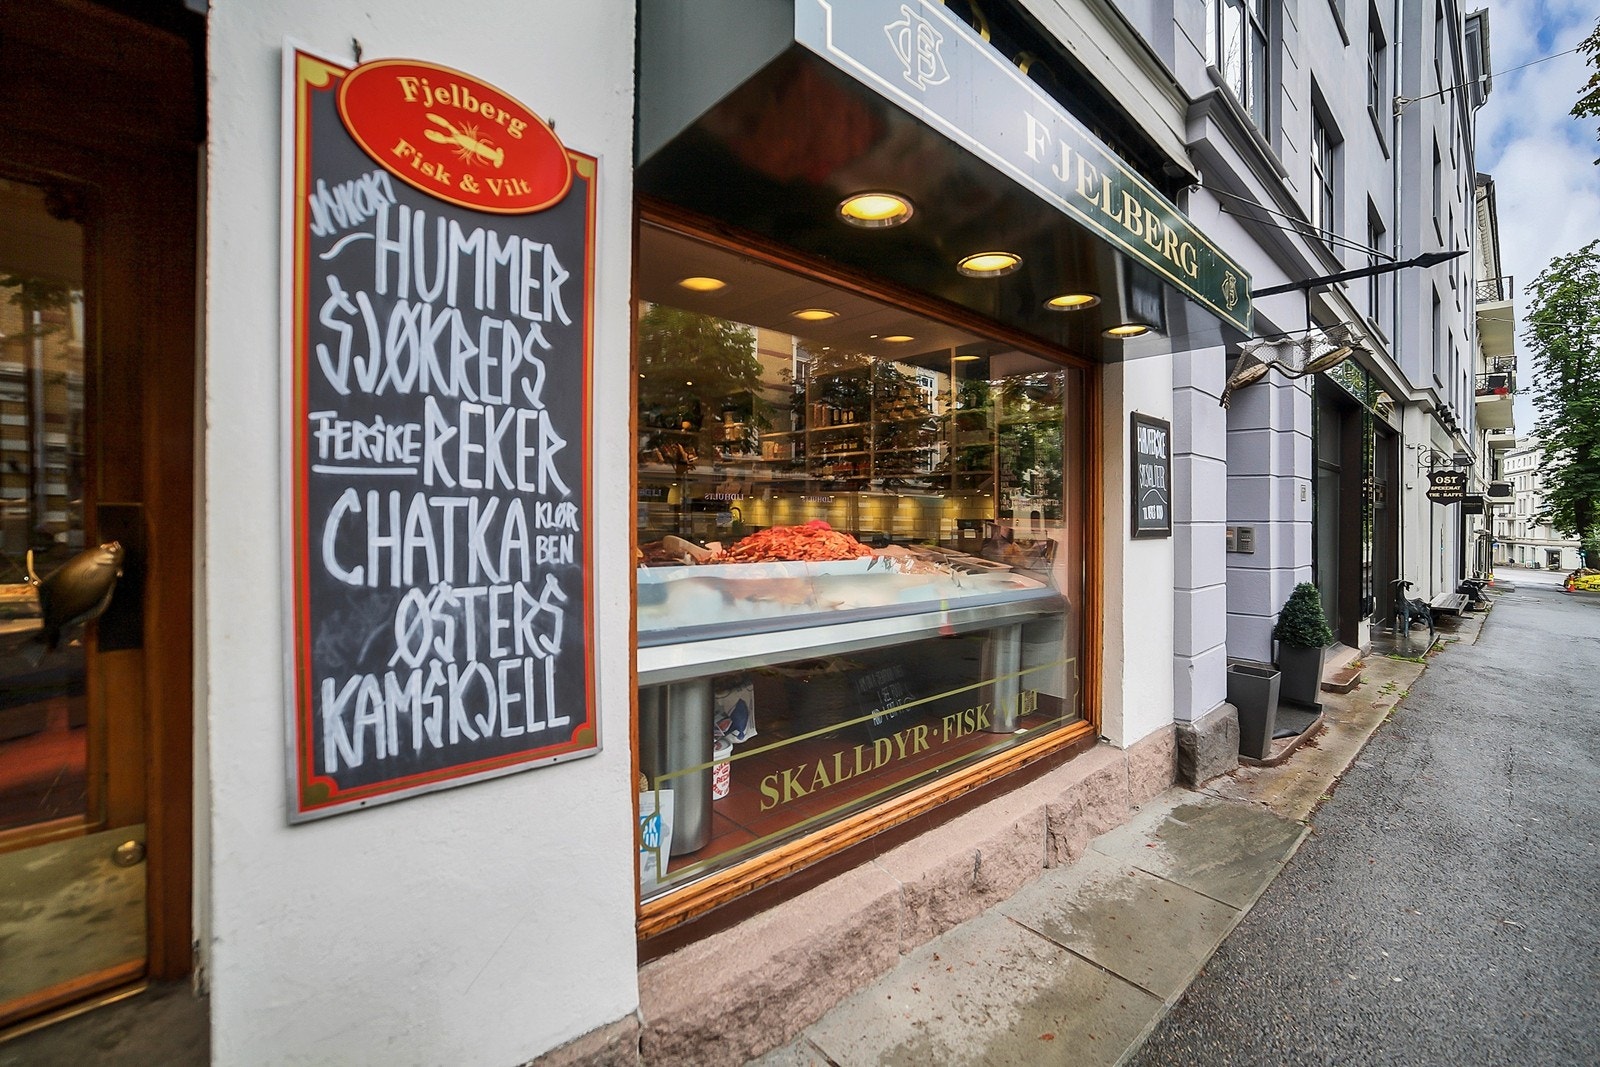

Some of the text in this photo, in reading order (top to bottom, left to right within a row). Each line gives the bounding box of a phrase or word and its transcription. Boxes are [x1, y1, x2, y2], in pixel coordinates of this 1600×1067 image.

[396, 75, 528, 140] Fjelberg
[391, 138, 532, 198] Fisk & Vilt
[1022, 109, 1200, 279] FJELBERG
[375, 204, 573, 327] HUMMER
[315, 274, 553, 410] SJØKREPS
[307, 395, 571, 498] FERSKE REKER
[321, 486, 532, 588] CHATKA
[535, 501, 580, 533] KLØR
[535, 534, 574, 565] BEN
[387, 573, 568, 669] ØSTERS
[320, 654, 571, 774] KAMSKJELL
[759, 725, 930, 812] SKALLDYR
[941, 702, 992, 743] FISK
